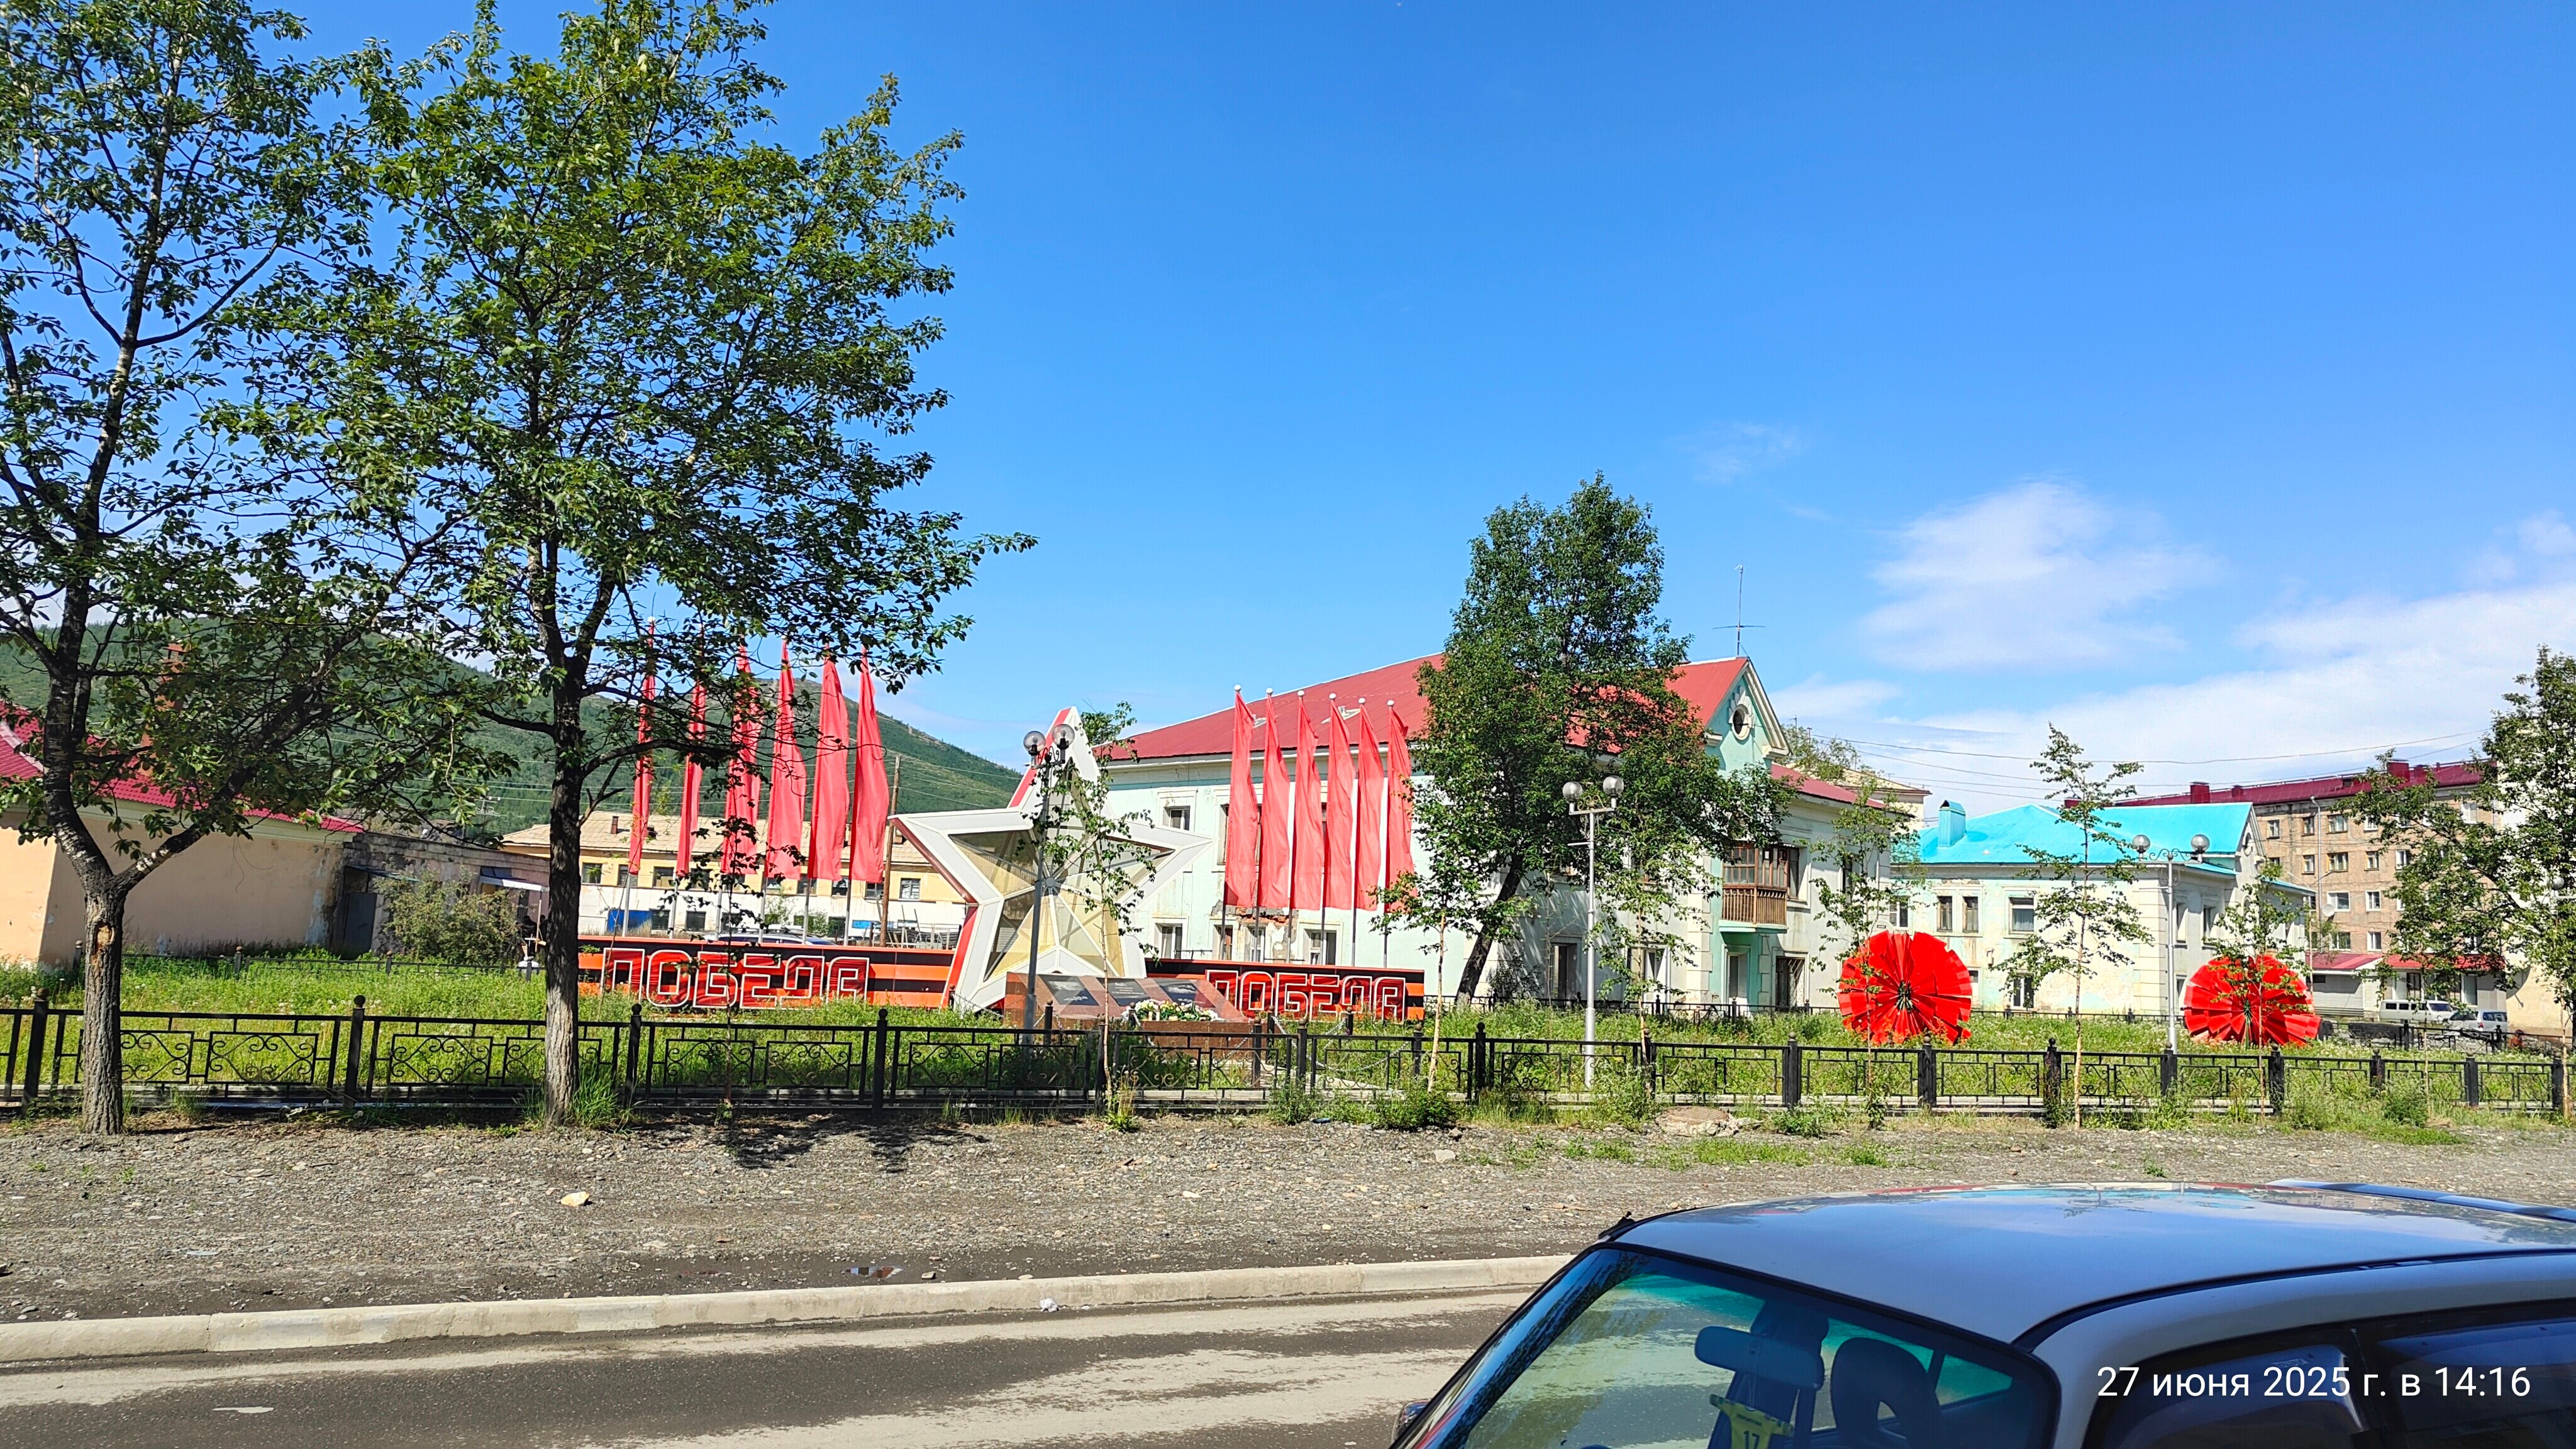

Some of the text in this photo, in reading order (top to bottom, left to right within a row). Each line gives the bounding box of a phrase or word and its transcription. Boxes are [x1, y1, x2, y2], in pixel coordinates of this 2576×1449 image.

[599, 947, 871, 1011] ПОБЕДА
[1206, 969, 1407, 1024] ПОБЕДА
[1743, 1430, 1760, 1449] 17
